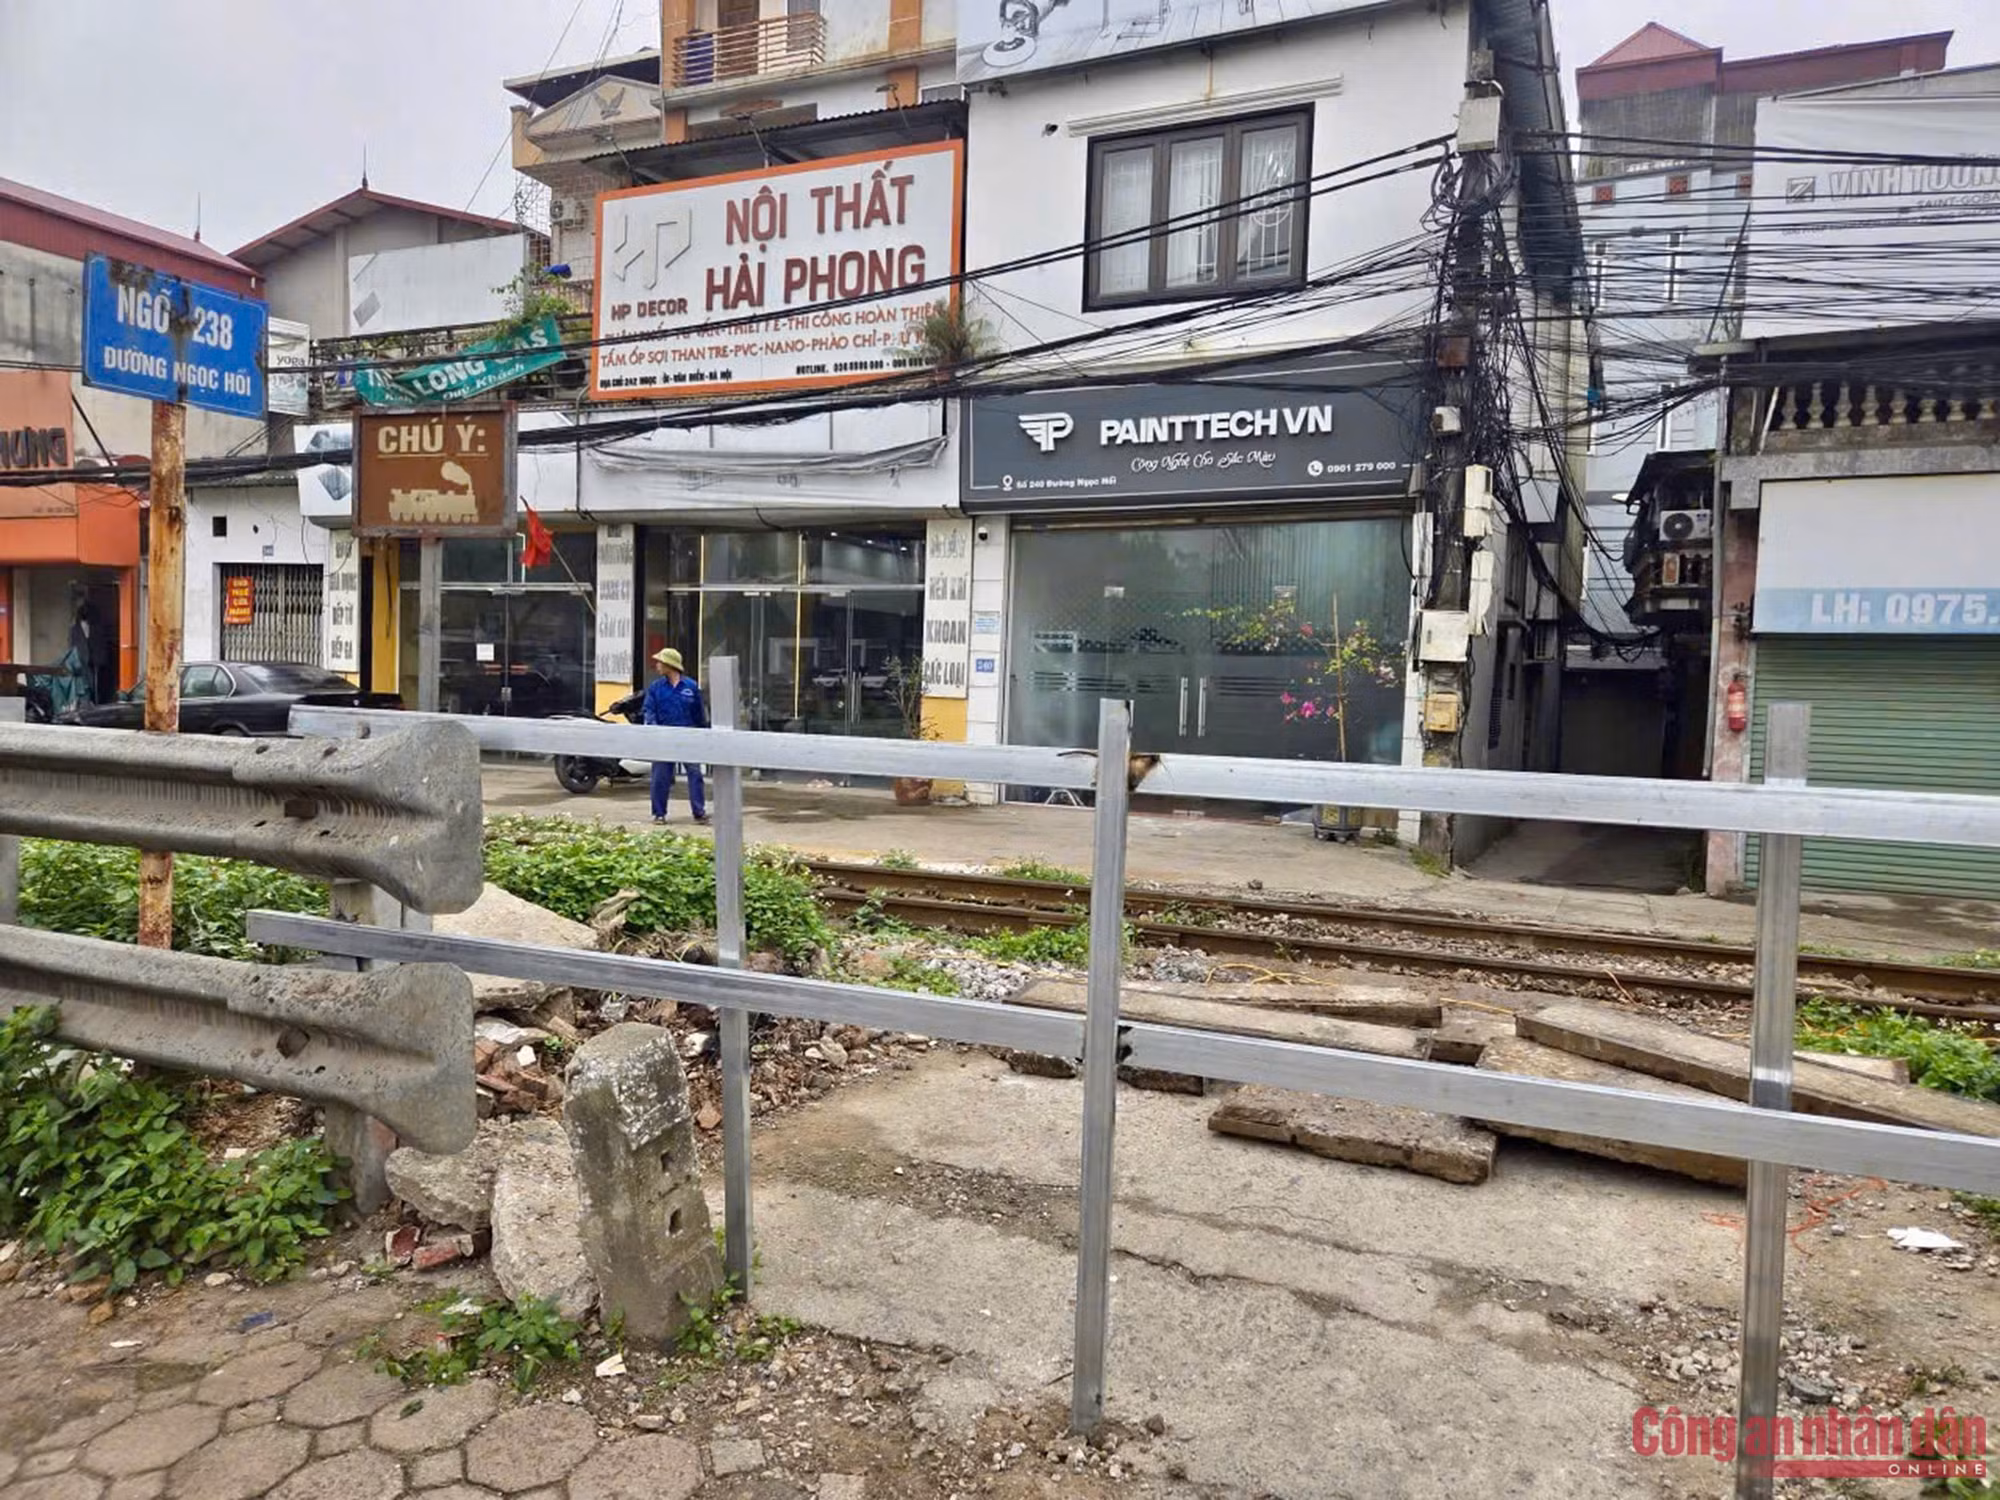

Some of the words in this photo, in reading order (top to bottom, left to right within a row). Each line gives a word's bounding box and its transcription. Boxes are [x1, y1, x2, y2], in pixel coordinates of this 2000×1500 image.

[726, 186, 788, 252] NỘI
[811, 161, 914, 234] THẤT
[706, 252, 765, 312] HẢI
[784, 245, 926, 304] PHONG
[117, 284, 171, 334] NGÕ
[192, 306, 232, 350] 238
[611, 304, 631, 321] HP
[637, 298, 688, 318] DECOR
[812, 308, 852, 328] CÔNG
[855, 302, 897, 323] HOÀN
[103, 346, 167, 379] ĐƯỜNG
[173, 362, 218, 393] NGỌC
[224, 368, 250, 396] HỒI
[601, 347, 627, 367] TẤM
[629, 345, 645, 365] ỐP
[648, 350, 668, 365] SỢI
[671, 347, 706, 363] THAN
[412, 359, 487, 396] LONG
[378, 417, 444, 454] CHÚ
[456, 416, 486, 452] Ý:
[1130, 456, 1159, 473] Công
[1193, 450, 1214, 468] Cho
[1327, 463, 1352, 474] 0901
[1355, 462, 1374, 472] 279
[1376, 461, 1397, 471] 000
[1812, 592, 1870, 624] LH:
[926, 619, 967, 646] KHOAN
[924, 657, 942, 685] CÁC
[944, 660, 966, 688] LOẠI
